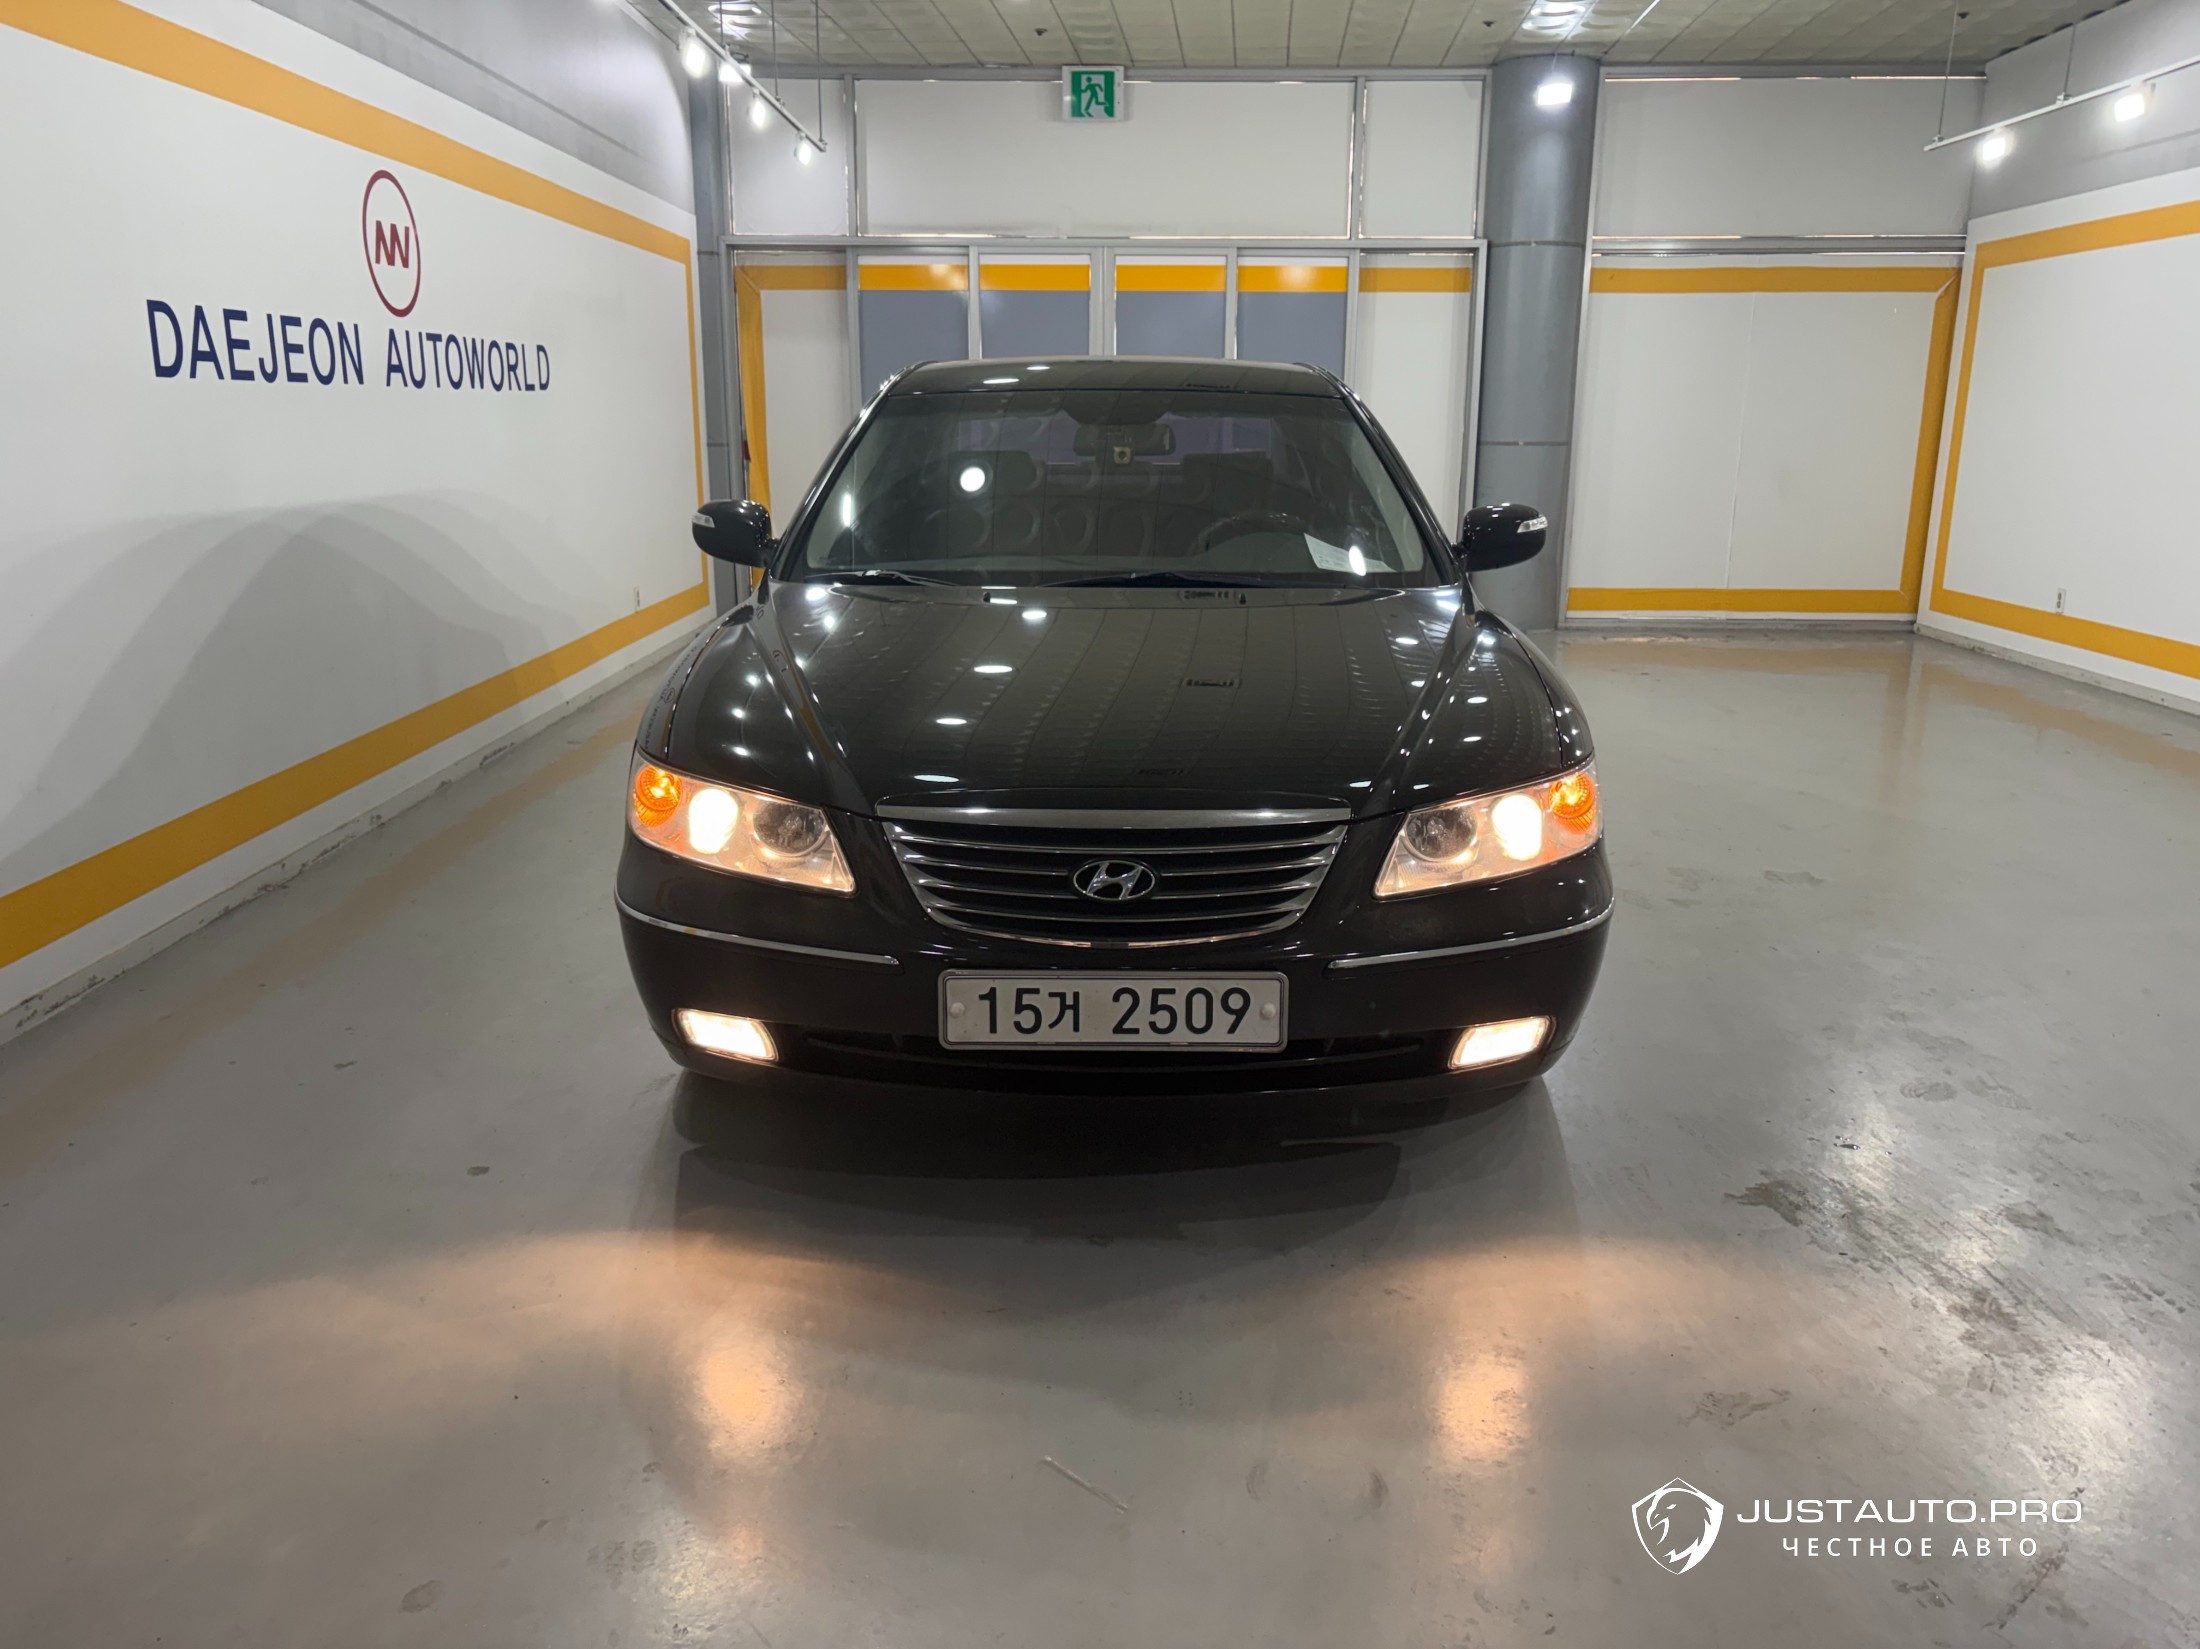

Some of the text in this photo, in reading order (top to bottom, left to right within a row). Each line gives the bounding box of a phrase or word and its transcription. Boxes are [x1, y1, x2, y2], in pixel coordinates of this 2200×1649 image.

[145, 298, 551, 392] DAEJEON AUTOWORLD
[978, 986, 1251, 1035] 15거 2509
